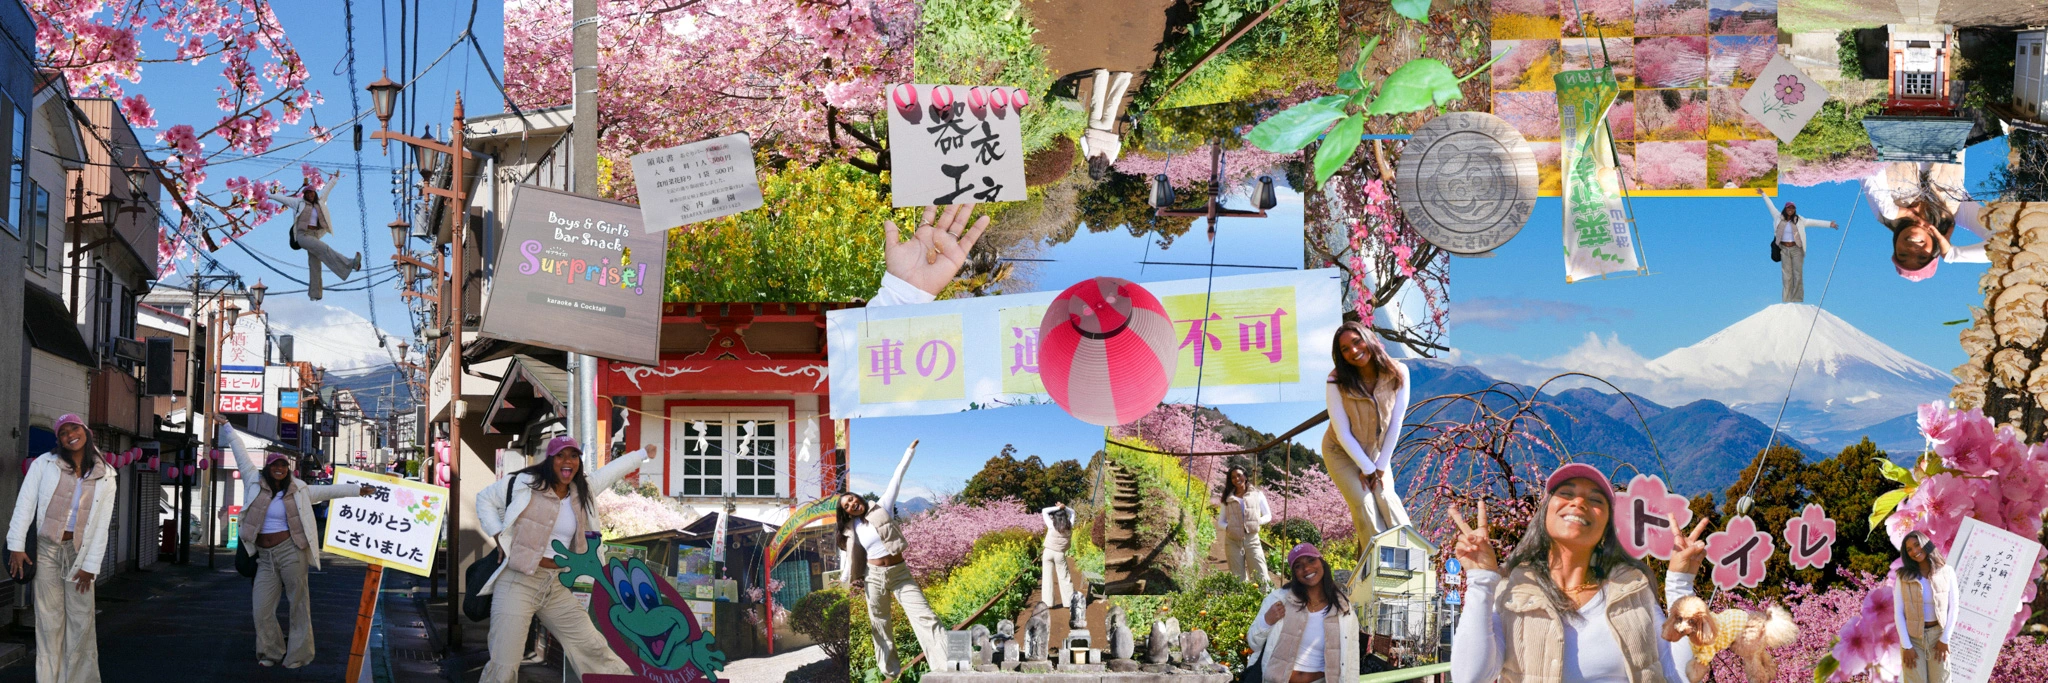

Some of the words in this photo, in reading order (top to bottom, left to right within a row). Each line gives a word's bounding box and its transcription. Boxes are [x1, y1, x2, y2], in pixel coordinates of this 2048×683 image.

[1409, 114, 1520, 153] MATSUDA
[646, 154, 674, 167] 領収書
[715, 166, 734, 175] 500円
[548, 211, 580, 231] Boys
[583, 217, 593, 229] &
[596, 220, 630, 237] Girl's
[554, 227, 579, 243] Bar
[581, 233, 622, 252] Snack
[518, 239, 647, 296] Surprise!
[547, 297, 572, 307] karaoke
[580, 302, 607, 313] Cocktail
[866, 338, 957, 386] 車の
[1173, 307, 1289, 368] 不可
[219, 395, 259, 412] たばこ
[338, 503, 412, 533] ありがとう
[334, 529, 424, 563] ございました
[641, 663, 663, 683] You
[678, 666, 697, 683] Life
